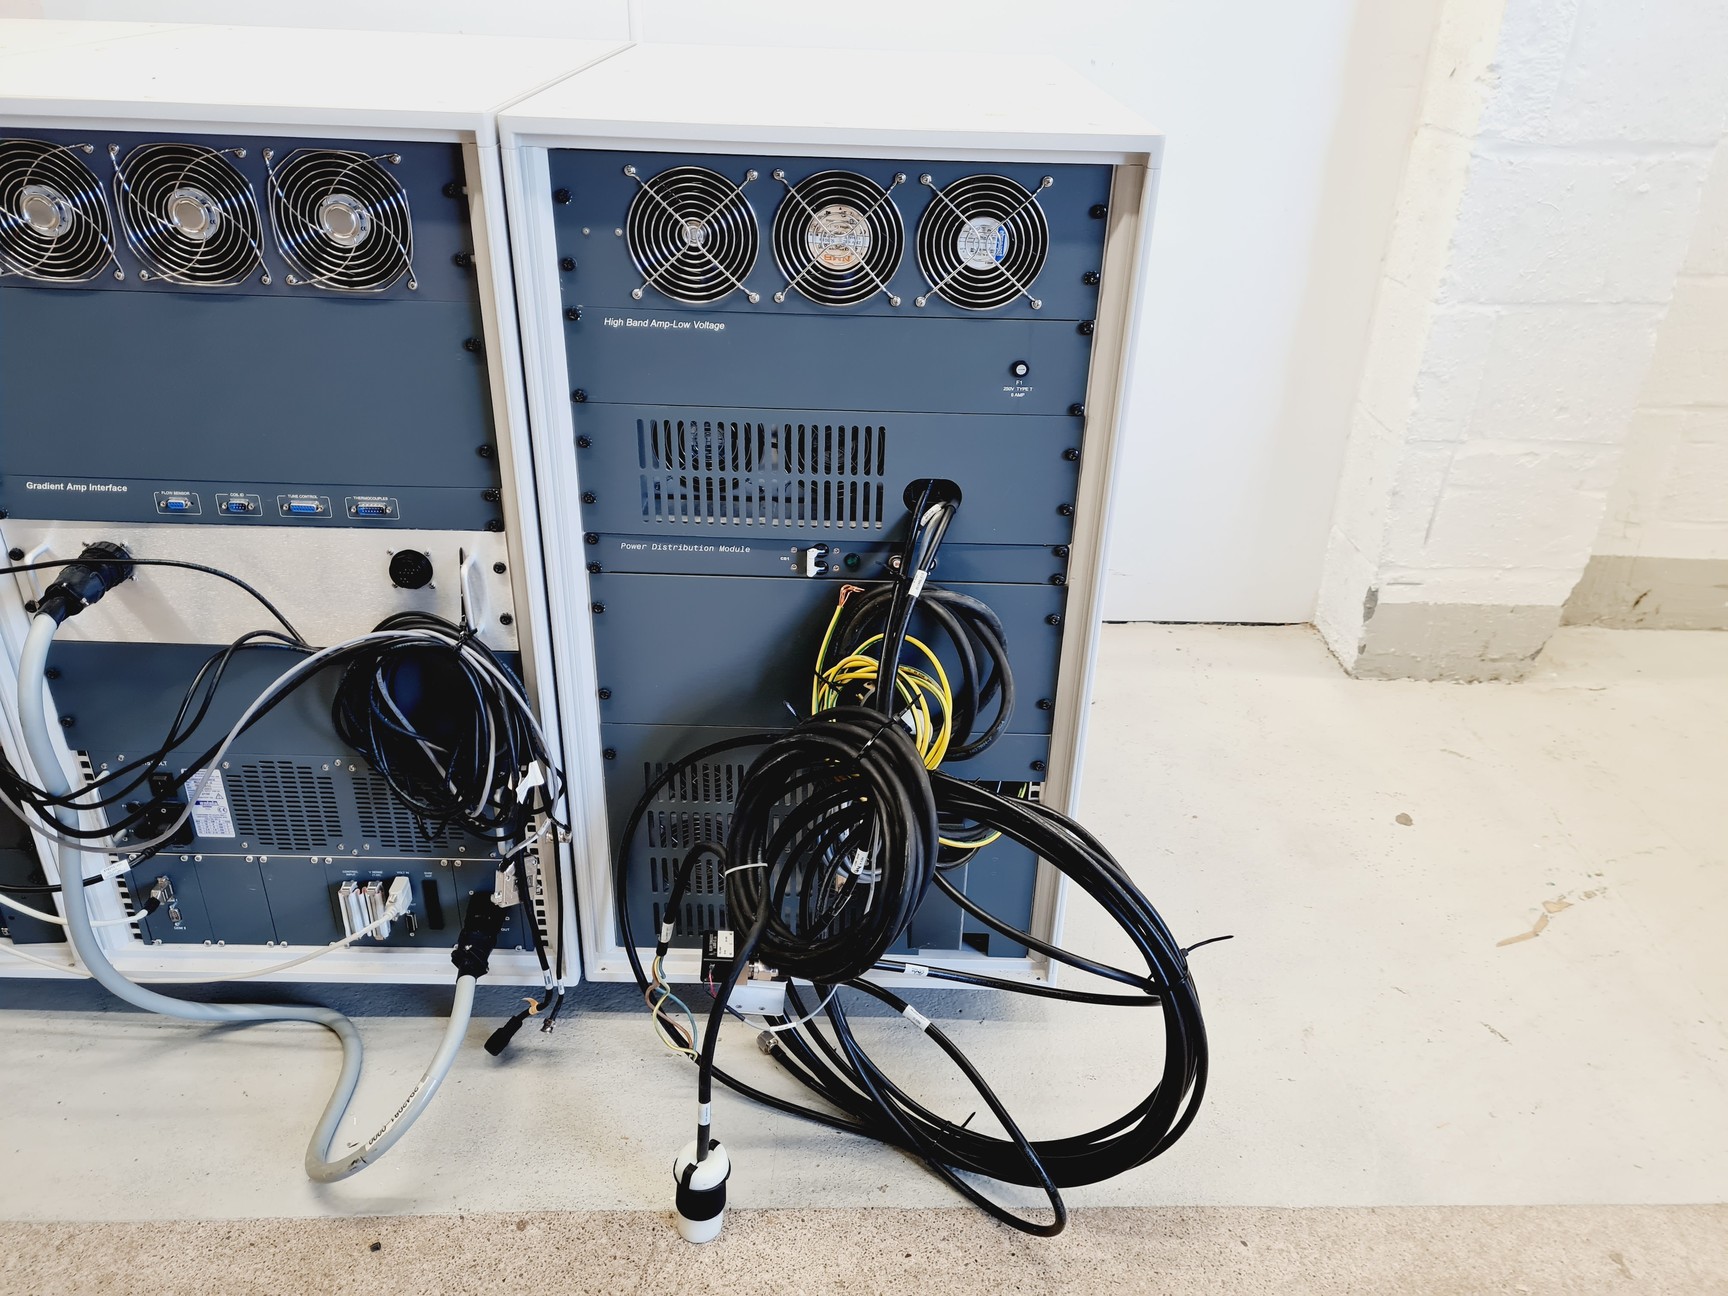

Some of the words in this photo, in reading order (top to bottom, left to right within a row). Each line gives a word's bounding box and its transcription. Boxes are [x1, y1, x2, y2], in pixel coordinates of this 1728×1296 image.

[604, 317, 624, 328] High
[626, 318, 649, 327] Band
[650, 319, 691, 329] Amp-Low
[693, 320, 725, 331] Voltage
[26, 481, 64, 490] Gradient
[66, 482, 87, 492] Amp
[89, 483, 128, 492] Interface
[620, 542, 647, 550] Power
[651, 543, 714, 552] Distribution
[719, 544, 751, 553] Module
